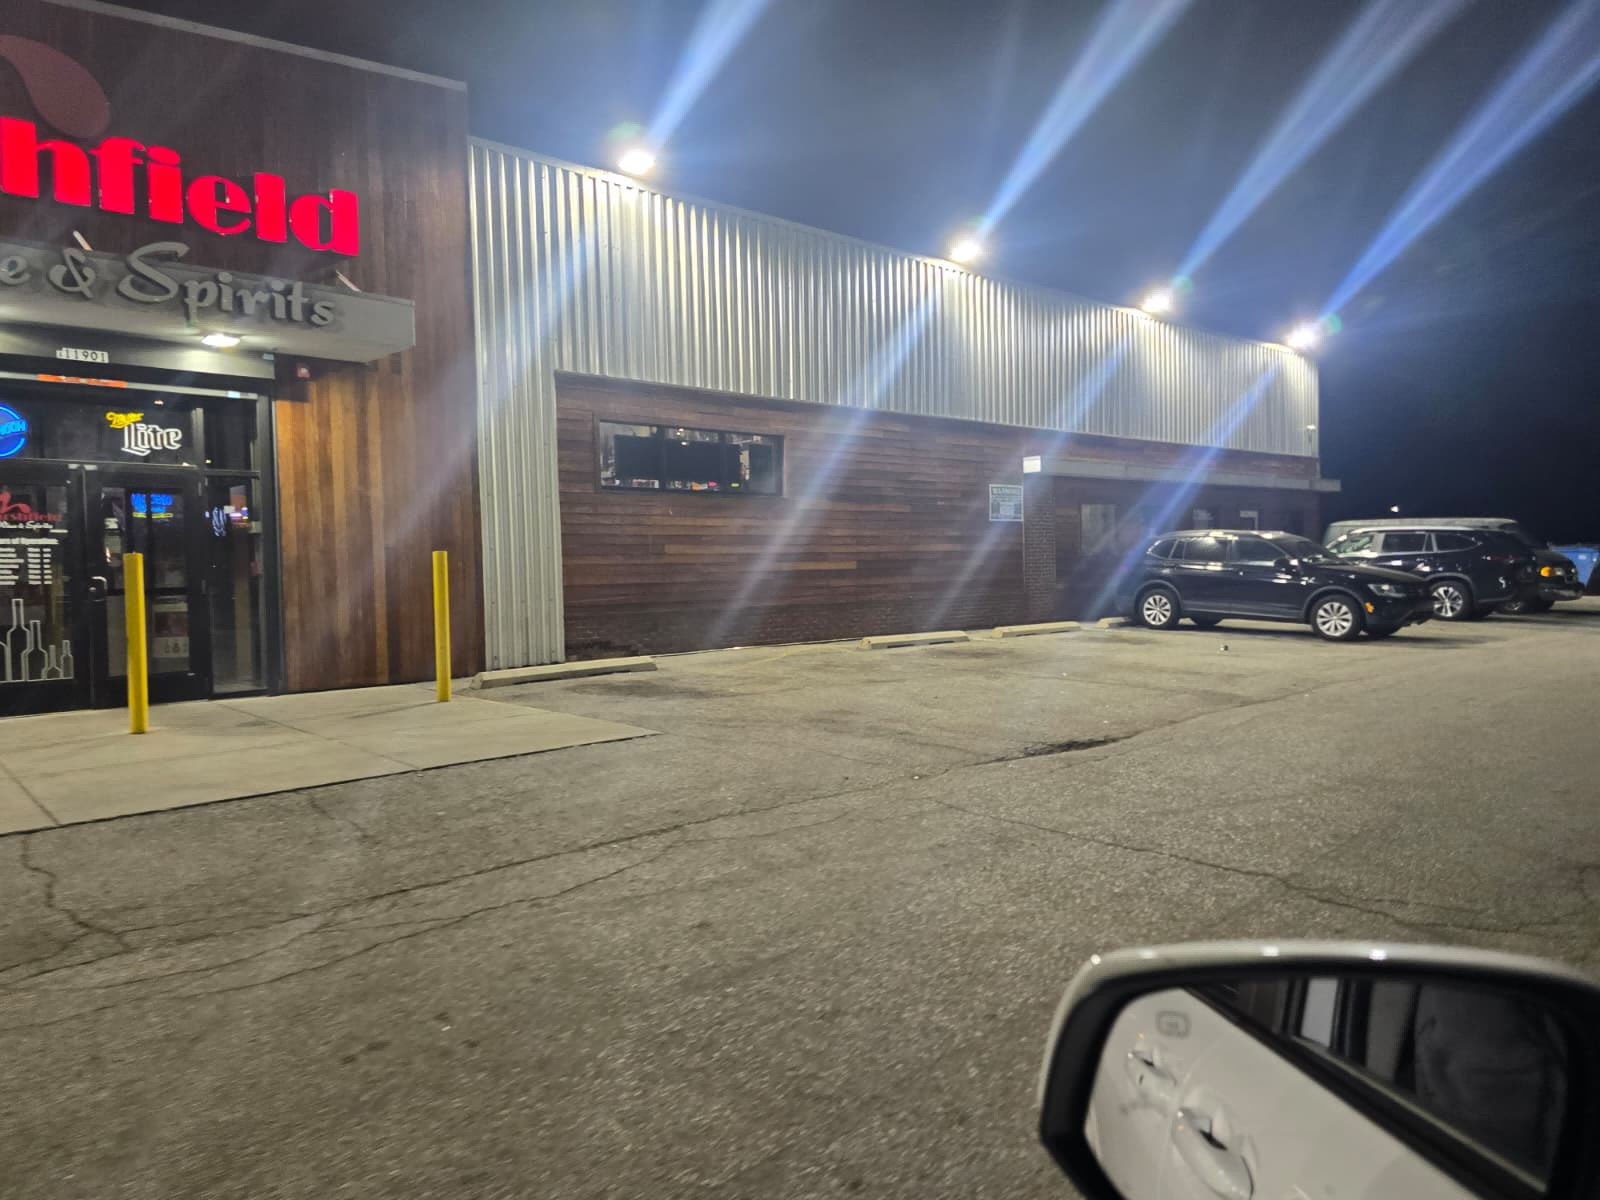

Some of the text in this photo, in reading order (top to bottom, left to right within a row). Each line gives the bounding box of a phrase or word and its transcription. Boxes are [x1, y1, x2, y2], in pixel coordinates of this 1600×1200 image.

[0, 115, 359, 256] hfield
[48, 247, 96, 299] &
[117, 241, 336, 326] Spirits
[64, 347, 107, 363] 11901
[121, 422, 183, 457] Lite
